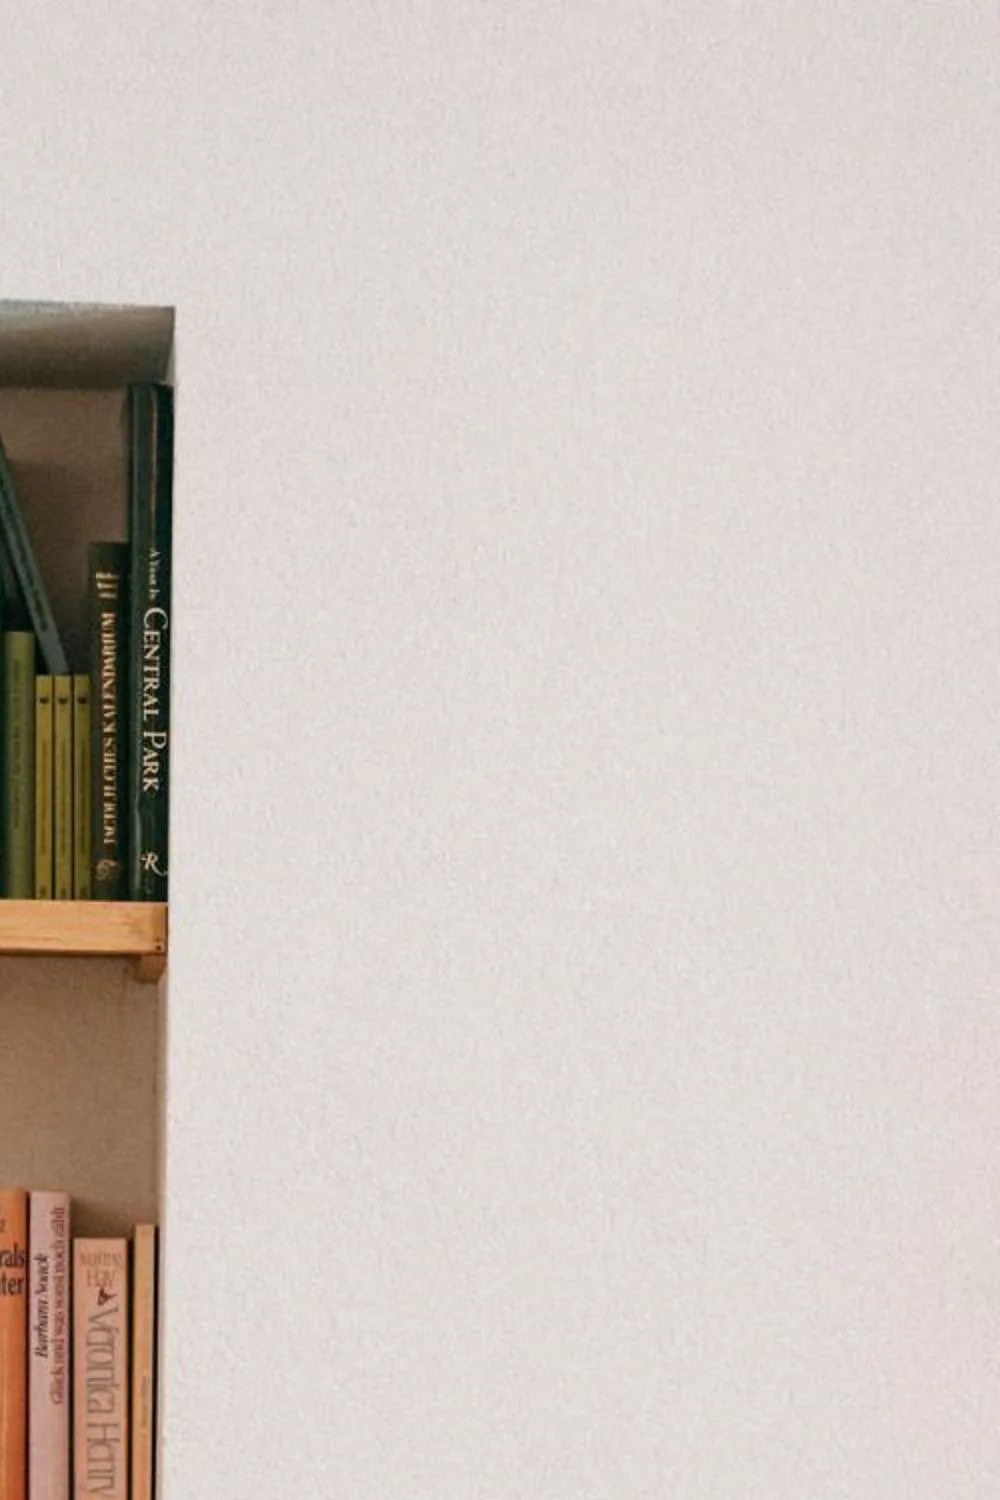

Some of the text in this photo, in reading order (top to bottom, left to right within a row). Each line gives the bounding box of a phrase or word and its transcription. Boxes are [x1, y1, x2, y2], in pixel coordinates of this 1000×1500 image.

[101, 611, 117, 733] KALENDARIUM
[85, 1305, 121, 1499] Veronica Henry
